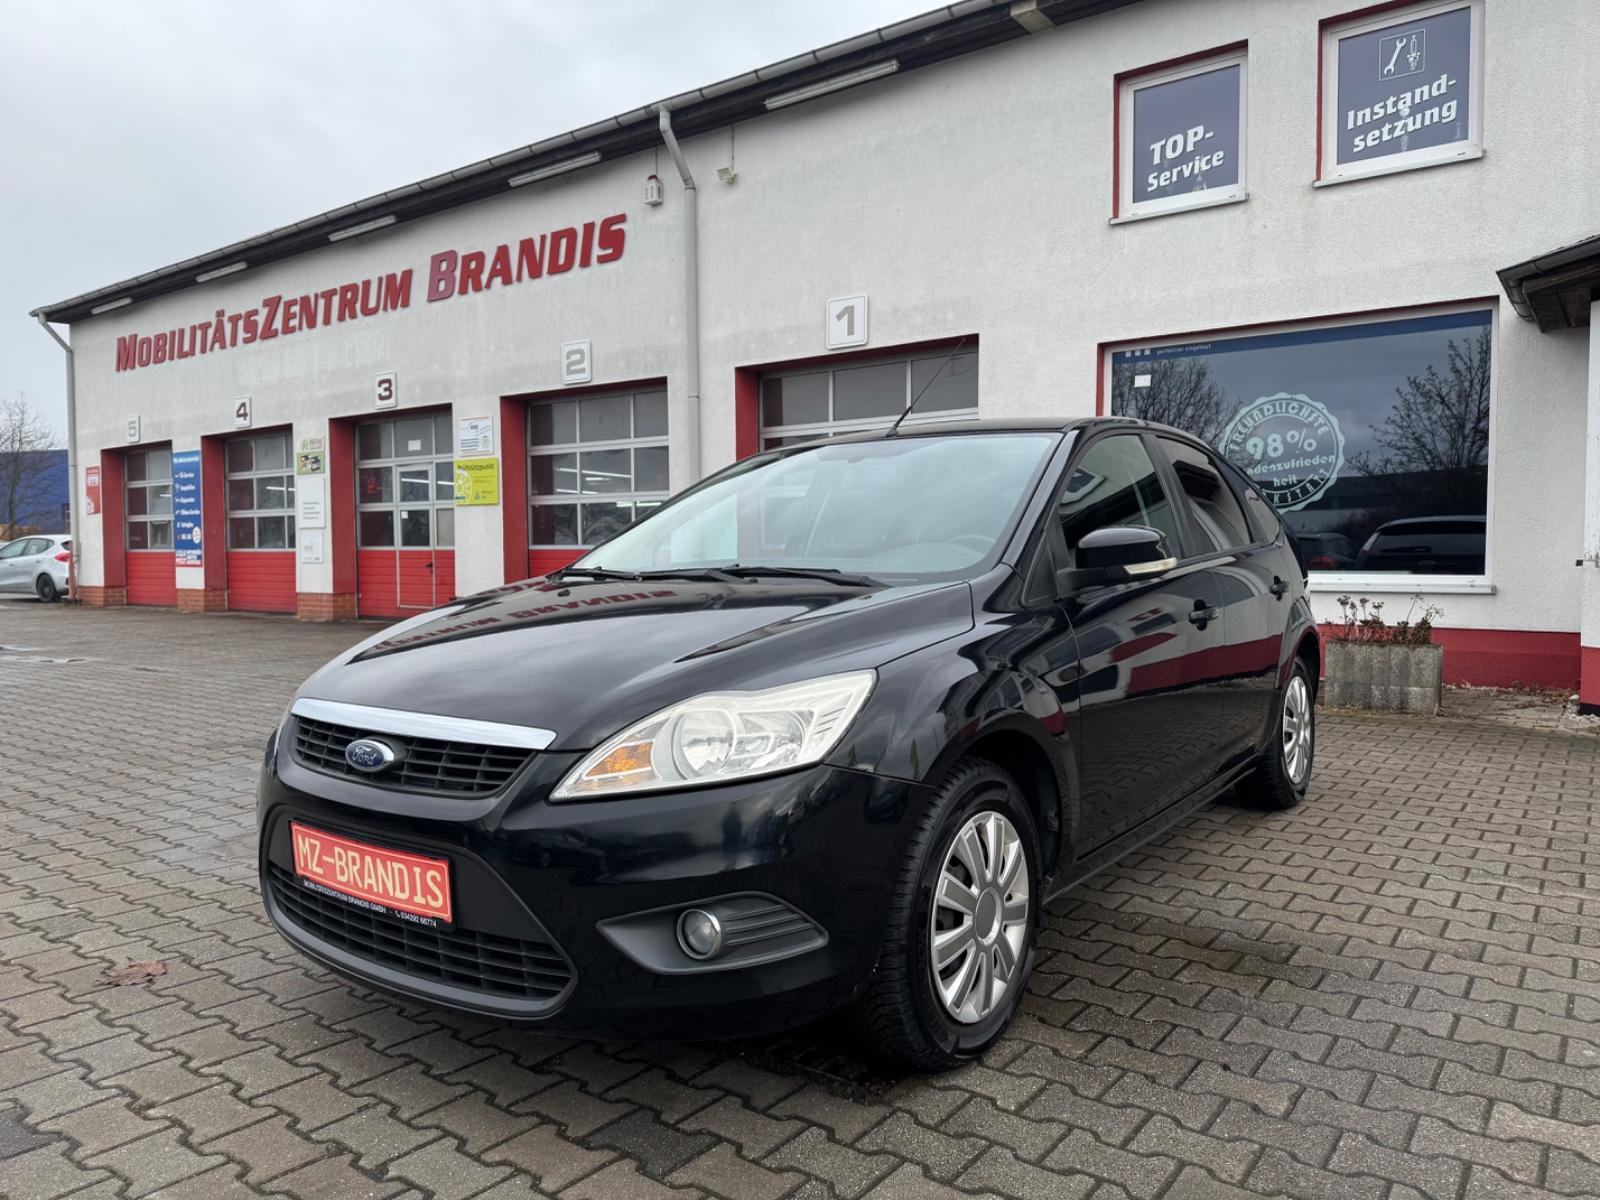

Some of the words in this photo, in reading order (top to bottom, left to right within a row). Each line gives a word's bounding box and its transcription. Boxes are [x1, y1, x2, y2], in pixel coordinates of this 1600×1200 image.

[1347, 74, 1457, 131] Instand-
[1353, 100, 1458, 153] setzung
[1150, 125, 1214, 166] TOP-
[1147, 150, 1224, 192] Service
[835, 305, 855, 337] 1
[565, 348, 586, 375] 2
[378, 378, 393, 401] 3
[236, 402, 249, 421] 4
[1229, 401, 1330, 451] FREUNDLICHSTE
[128, 420, 137, 438] 5
[1245, 455, 1335, 475] ndenzufrieden
[1274, 474, 1298, 487] heit
[352, 745, 377, 766] Ford
[298, 834, 444, 908] MZ-BRANDIS
